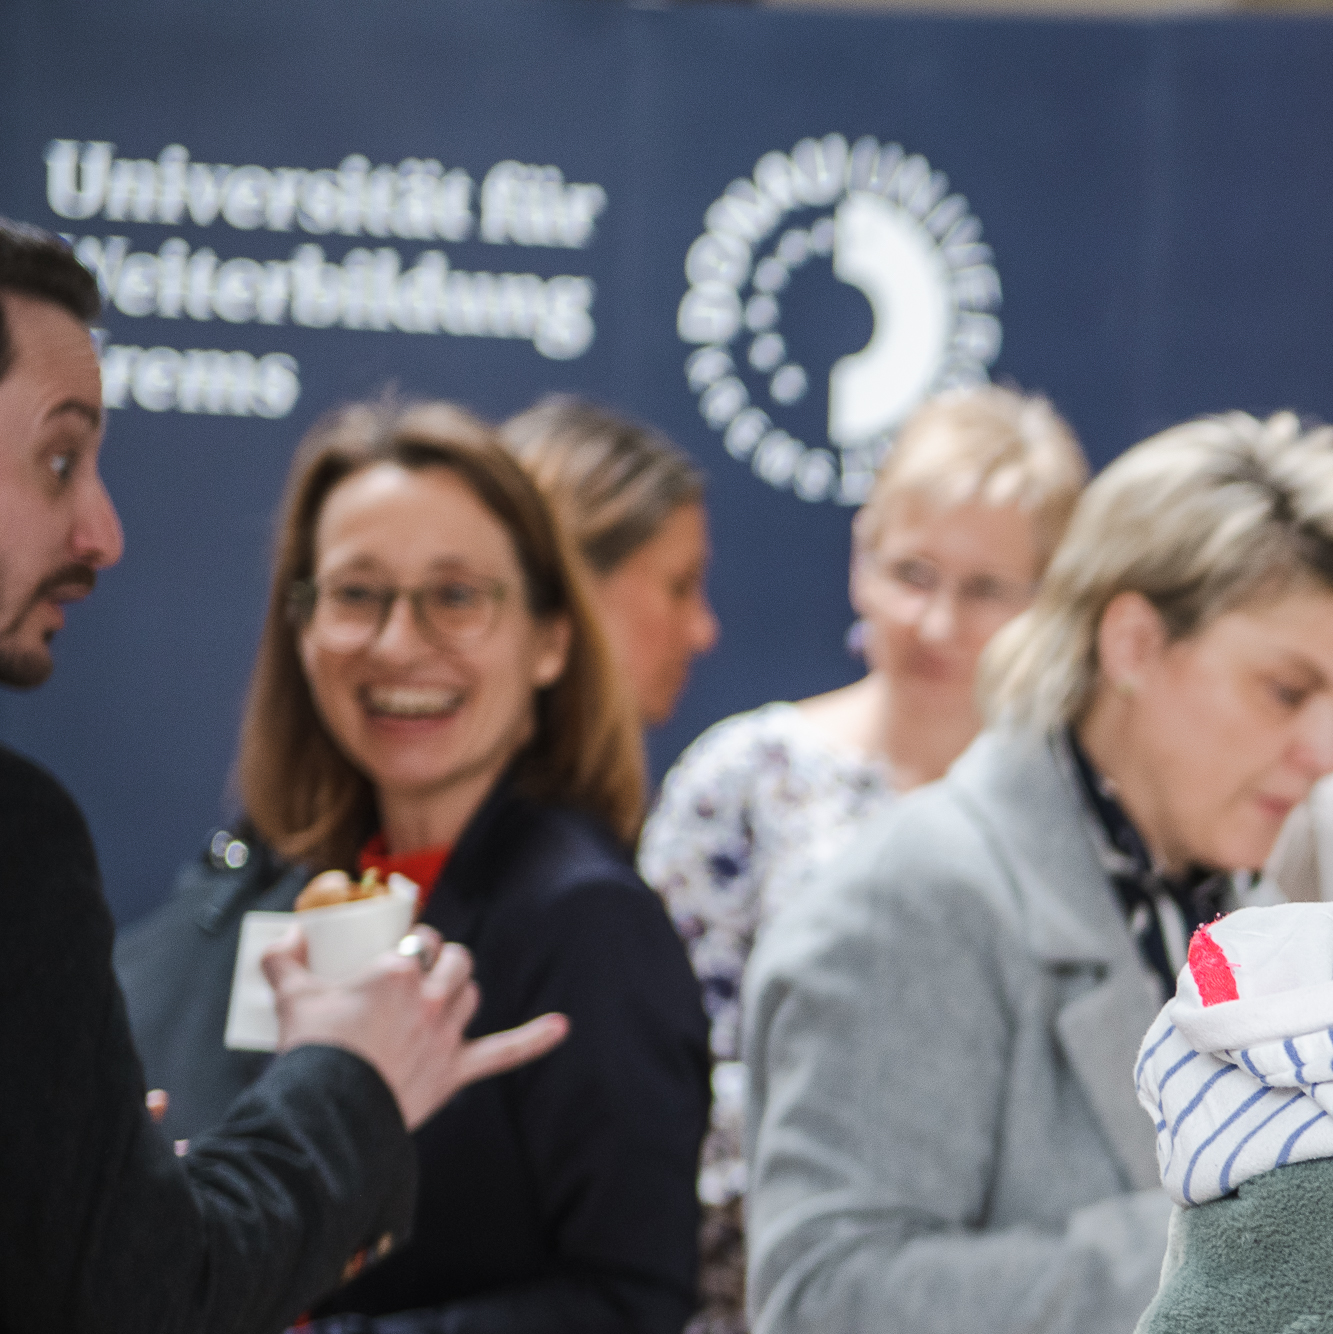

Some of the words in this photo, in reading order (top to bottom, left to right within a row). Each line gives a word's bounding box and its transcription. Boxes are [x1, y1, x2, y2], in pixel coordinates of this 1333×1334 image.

[46, 138, 472, 243] Universität
[480, 160, 607, 249] für
[90, 327, 300, 419] rems
